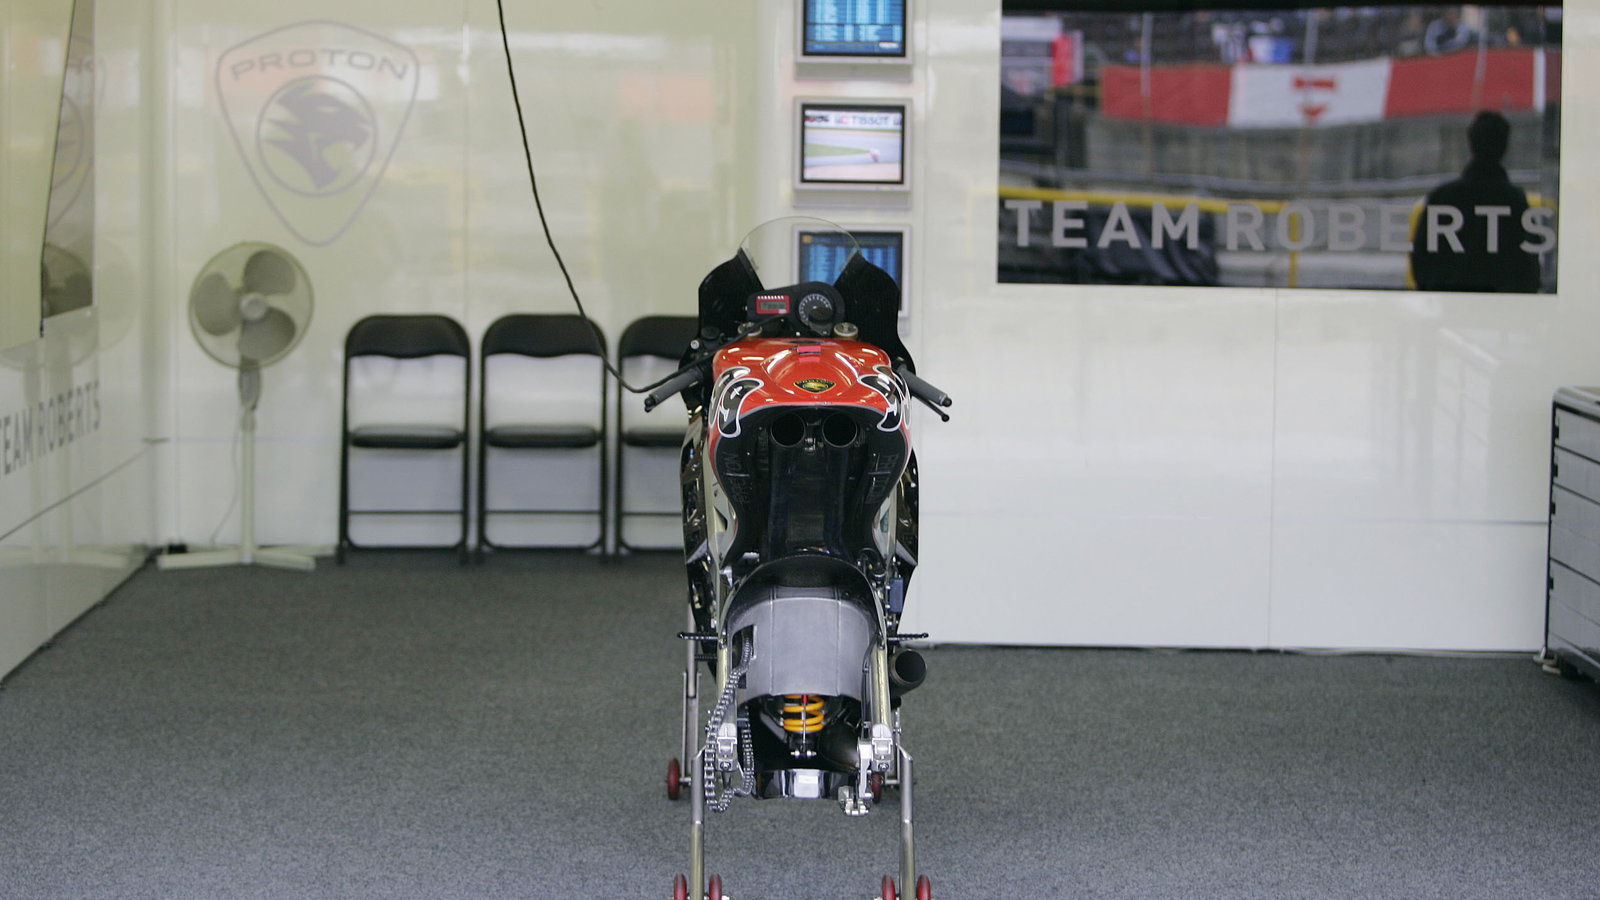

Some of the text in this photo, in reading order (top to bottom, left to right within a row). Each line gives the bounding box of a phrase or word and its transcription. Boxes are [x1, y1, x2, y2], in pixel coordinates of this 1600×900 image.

[230, 48, 409, 81] PROTON
[1004, 199, 1556, 254] TEAM ROBERTS
[0, 380, 101, 475] EAM ROBERTS
